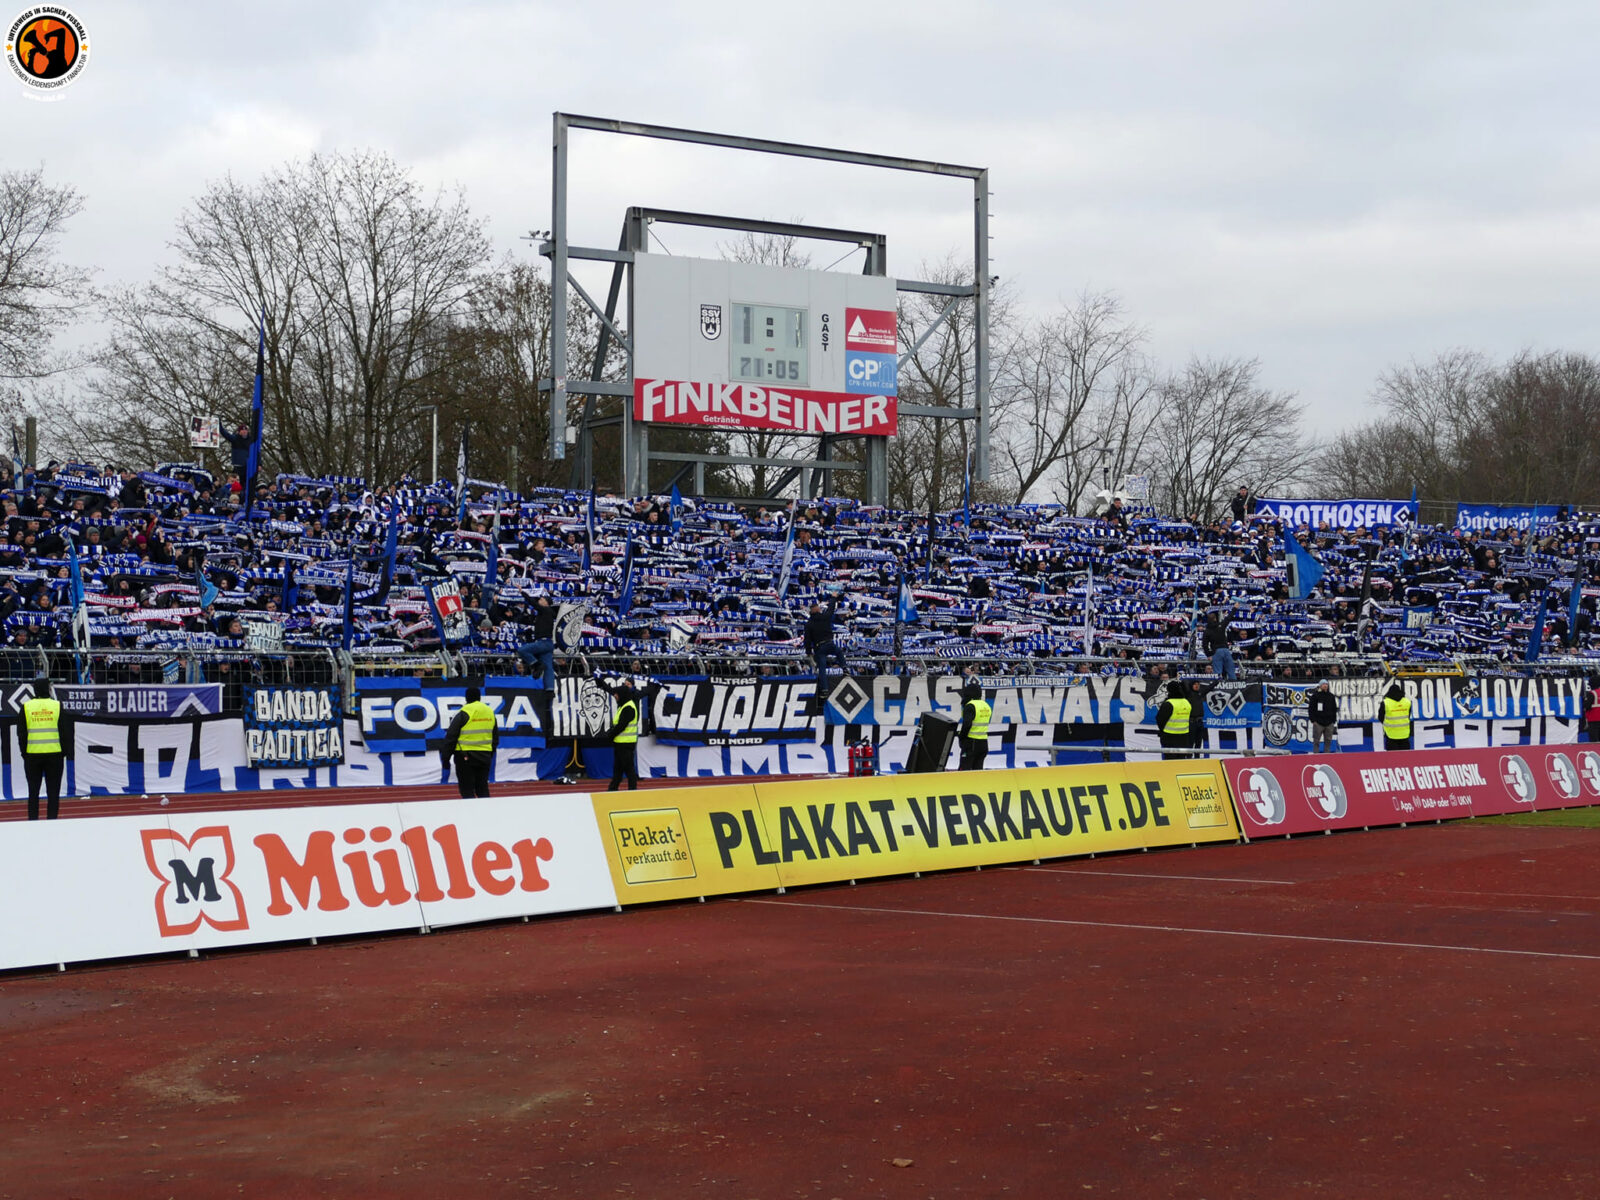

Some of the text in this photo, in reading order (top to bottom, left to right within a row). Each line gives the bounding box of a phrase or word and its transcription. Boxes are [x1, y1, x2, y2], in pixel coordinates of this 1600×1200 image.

[701, 309, 720, 317] SSV
[821, 313, 830, 352] GAST
[643, 379, 889, 433] FINKBEINER
[702, 414, 741, 425] Getränke
[1278, 504, 1393, 529] ROTHOSEN
[710, 676, 757, 685] ULTRAS
[982, 677, 1012, 687] SEKTION
[1014, 677, 1069, 687] STADIONVERBOT
[1214, 681, 1247, 690] AMBURG
[1328, 678, 1386, 695] VORSTADT
[62, 701, 101, 710] REGION
[68, 691, 94, 700] EINE
[107, 690, 168, 713] BLAUER
[254, 689, 333, 722] BANDA
[873, 675, 1147, 725] CASAWAYS
[1480, 678, 1582, 718] LOYALTY
[654, 683, 818, 735] CLIQUE
[1206, 717, 1248, 726] HOOLIGANS
[708, 737, 763, 745] DU NORD
[1359, 763, 1488, 794] EINFACH GUTE MUSIK.
[1507, 760, 1528, 797] 3
[1553, 757, 1573, 793] 3
[1181, 785, 1218, 801] Plakat-
[1249, 774, 1275, 818] 3
[1313, 770, 1337, 813] 3
[1421, 798, 1437, 809] DAB+
[1437, 797, 1450, 808] oder
[1457, 795, 1473, 806] UKW
[1187, 803, 1223, 815] verkauft.de
[708, 780, 1171, 869] PLAKAT-VERKAUFT.DE
[618, 825, 682, 847] Plakat-
[625, 848, 688, 865] verkauft.de
[168, 857, 222, 904] M
[253, 823, 554, 917] Müller
